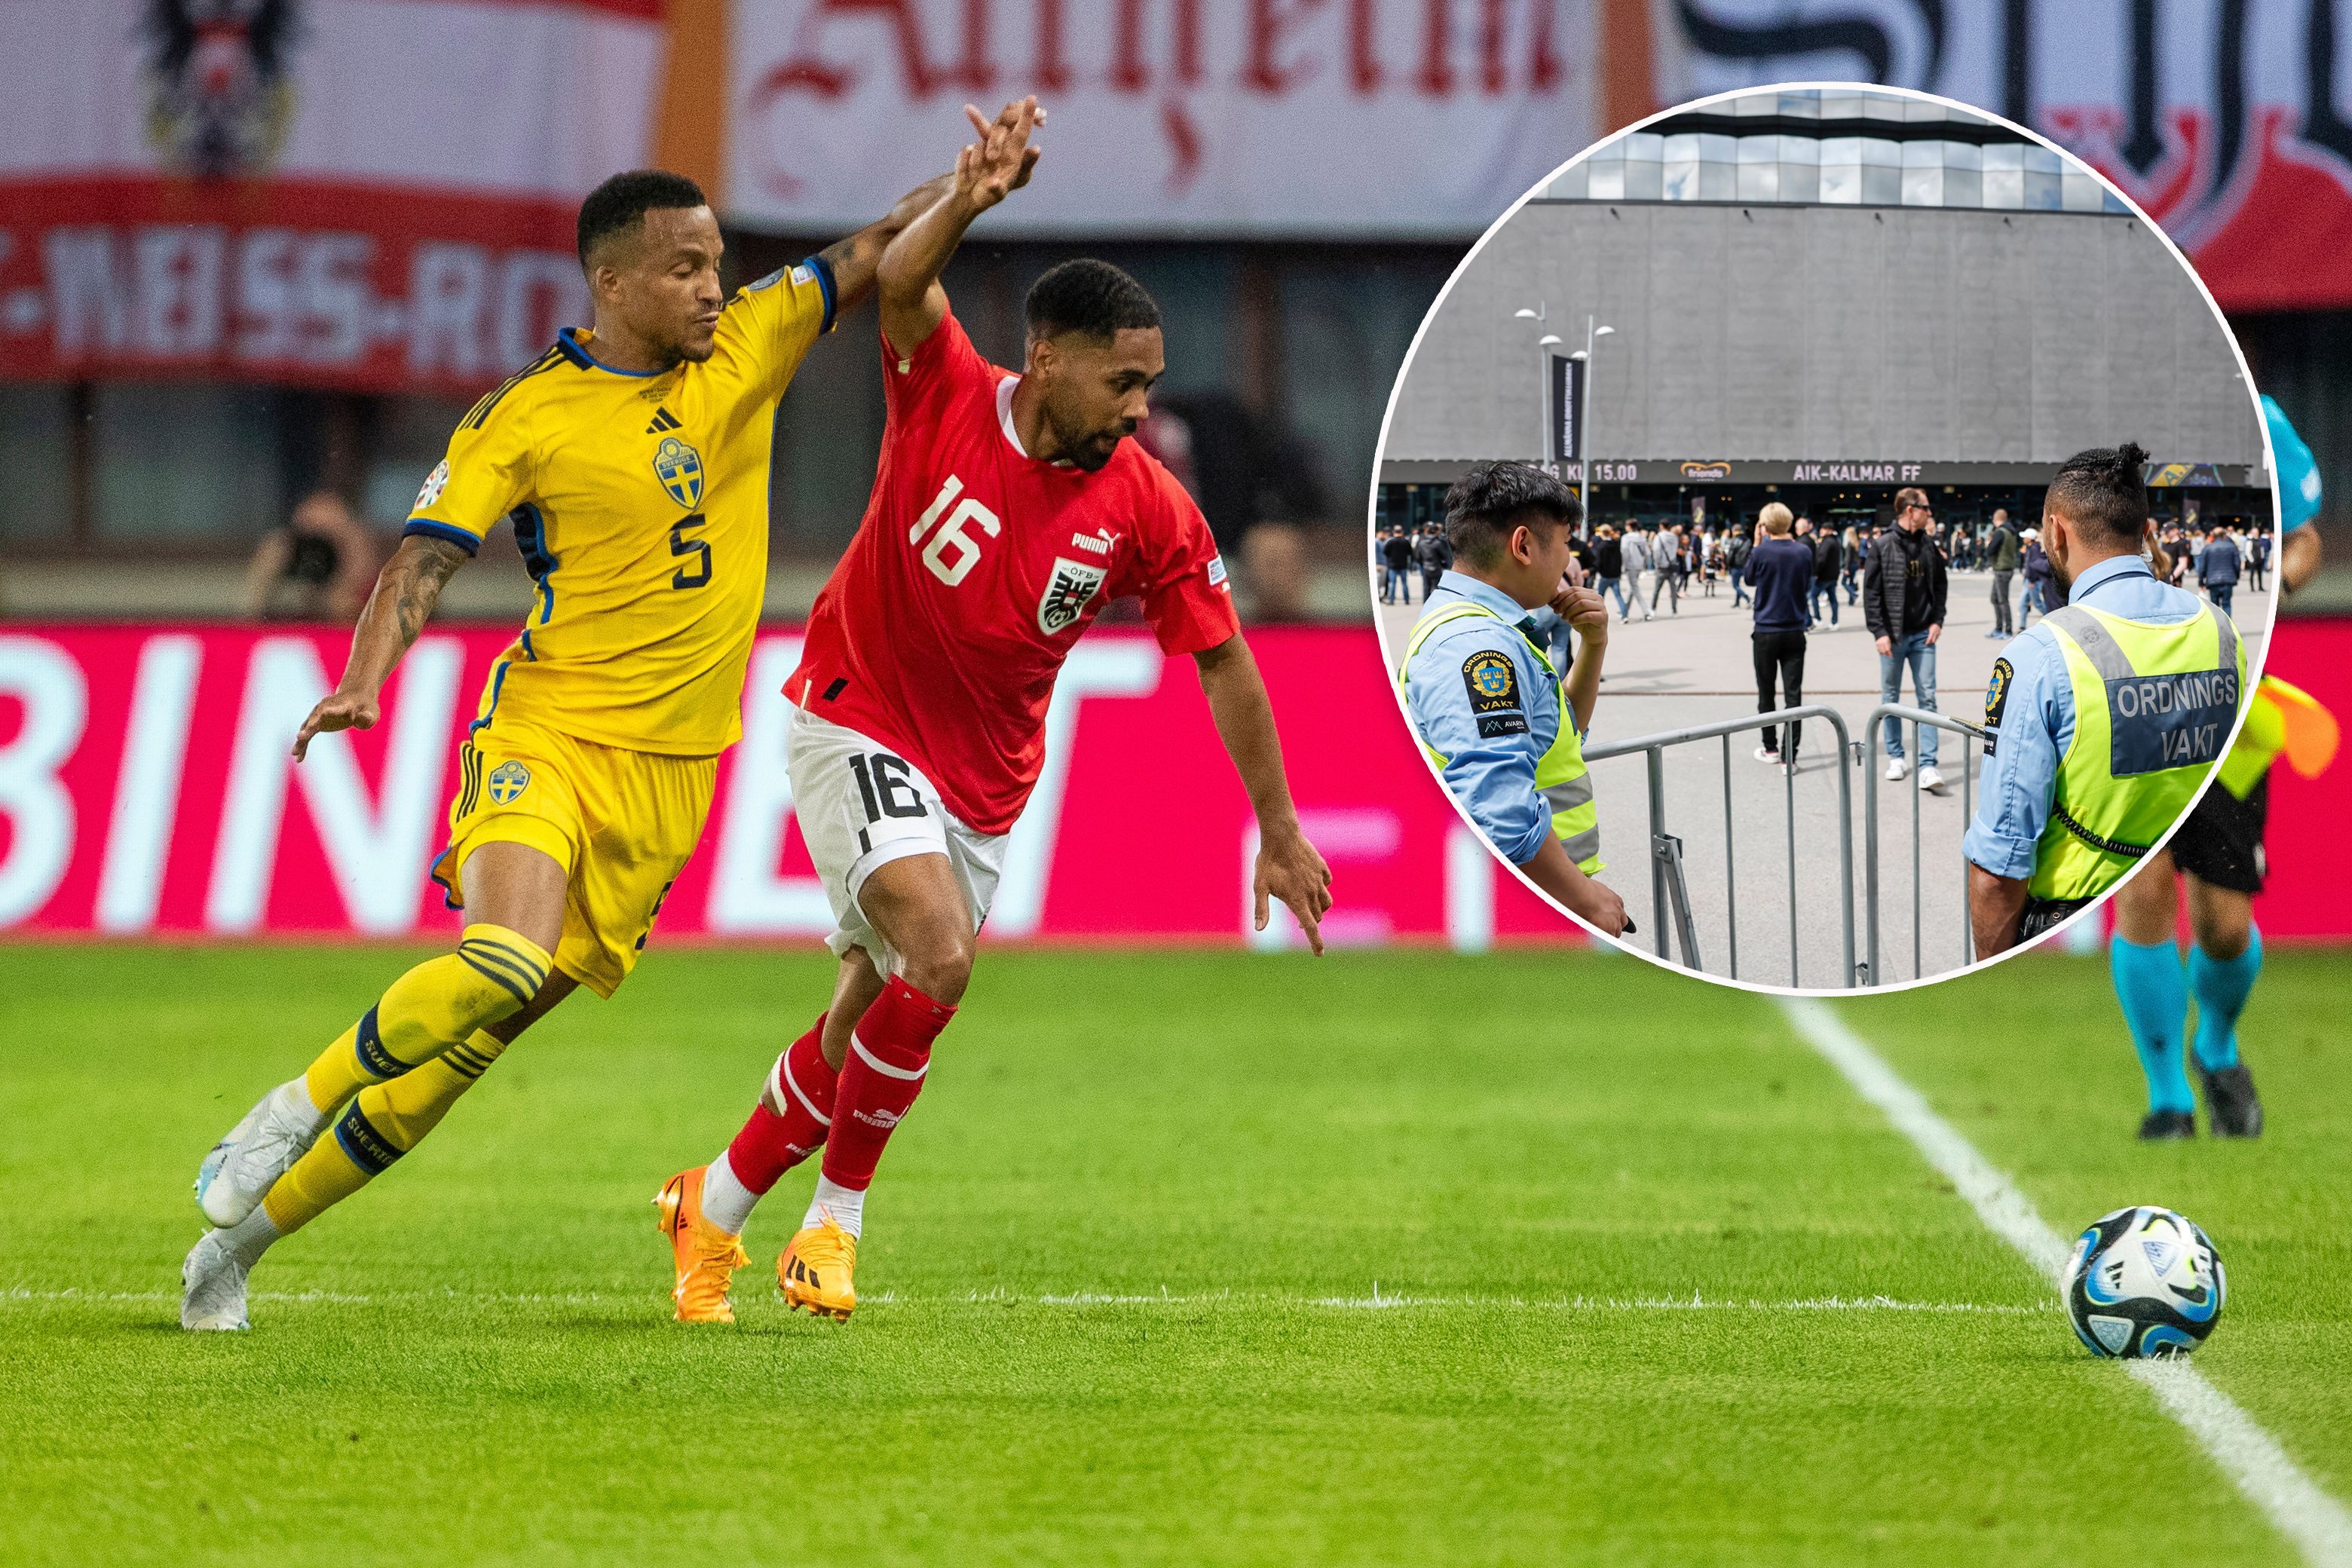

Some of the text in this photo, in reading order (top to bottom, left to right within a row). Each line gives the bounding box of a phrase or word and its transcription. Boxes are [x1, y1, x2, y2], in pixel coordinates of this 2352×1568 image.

[1595, 464, 1637, 481] 15.00
[1793, 464, 1922, 482] AIK-KALMAR FF
[909, 473, 1001, 588] 16
[669, 513, 712, 590] 5
[1071, 531, 1109, 555] PUMA
[1070, 566, 1094, 580] ÖFB
[1463, 651, 1513, 673] ORDNINGS
[1480, 700, 1514, 711] VAKT
[2117, 674, 2237, 718] ORDNINGS
[1985, 715, 1998, 724] KT
[2161, 723, 2219, 762] VAKT
[848, 753, 929, 825] 16
